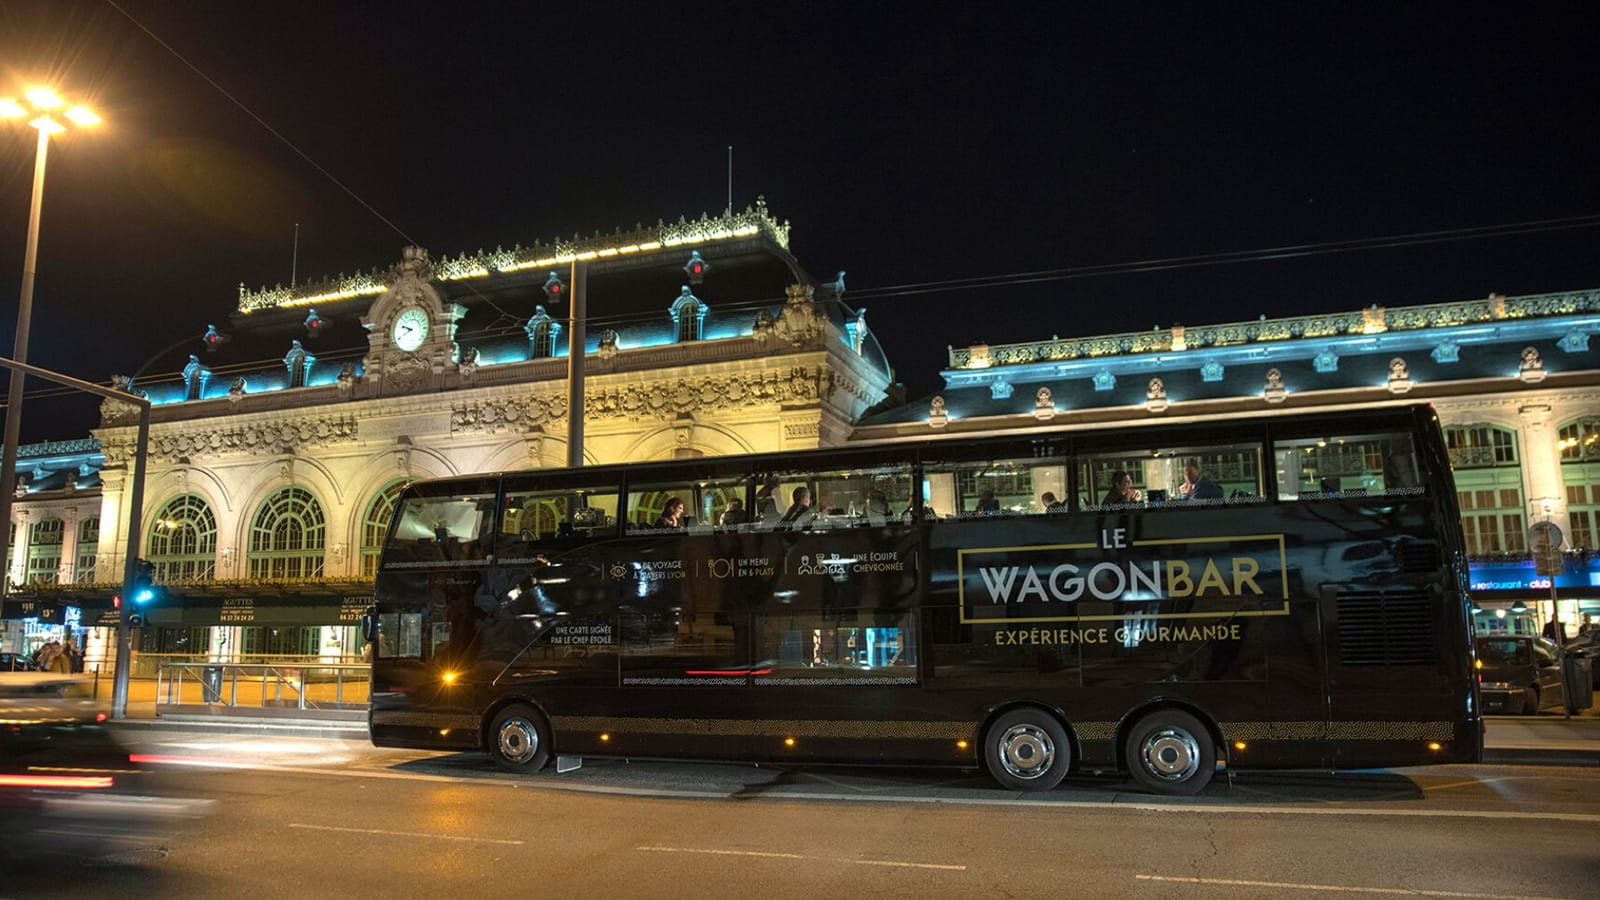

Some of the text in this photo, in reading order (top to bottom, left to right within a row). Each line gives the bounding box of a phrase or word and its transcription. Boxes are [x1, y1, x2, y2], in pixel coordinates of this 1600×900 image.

[1102, 528, 1126, 549] LE
[853, 551, 897, 561] UNE ÉQUIPE
[652, 560, 682, 569] VOYAGE
[738, 557, 769, 567] UN MENU
[738, 567, 774, 577] EN 6 PLATS
[853, 562, 904, 573] CHEVRONNÉE
[667, 570, 686, 579] LYON
[979, 557, 1264, 604] WAGONBAR
[1477, 581, 1521, 590] restaurant
[1529, 580, 1552, 589] club
[555, 625, 612, 634] UNE CARTE SIGNÉE
[550, 634, 612, 644] PAR LE CHEF ÉTOILÉ
[994, 624, 1241, 646] EXPÉRIENCE GOURMANDE
